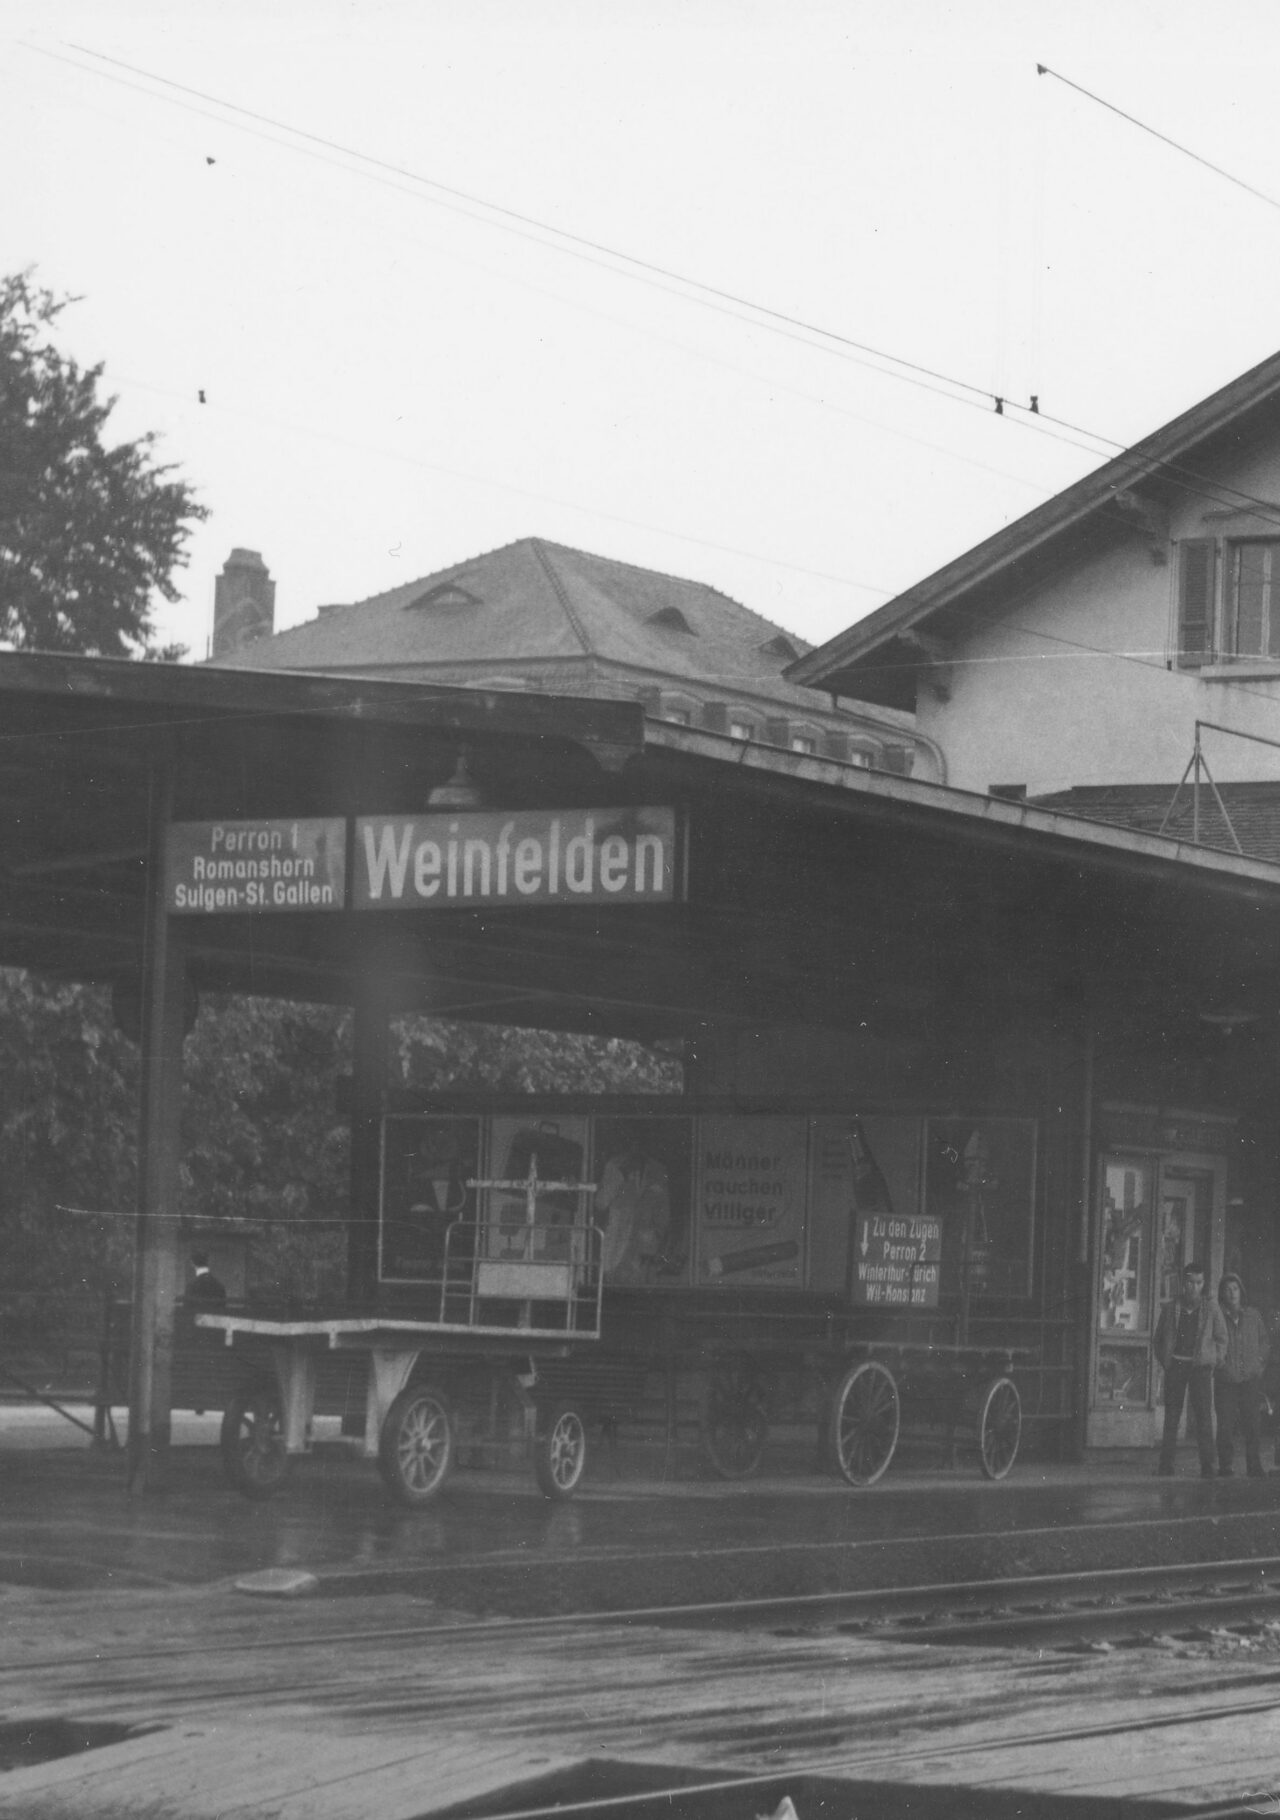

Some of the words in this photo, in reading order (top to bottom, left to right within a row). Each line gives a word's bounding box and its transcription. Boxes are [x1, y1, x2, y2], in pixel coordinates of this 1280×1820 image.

[212, 826, 282, 850] Perron
[290, 824, 298, 848] 1
[193, 857, 315, 880] Romanshorn
[363, 818, 664, 899] Weinfelden
[175, 884, 270, 911] Sulgen-St.
[273, 883, 333, 905] Gallen
[705, 1179, 783, 1195] rauchen
[704, 1202, 777, 1225] Villiger
[873, 1216, 886, 1237] Zu
[888, 1219, 906, 1238] den
[883, 1241, 916, 1260] Perron
[919, 1242, 926, 1261] 2
[858, 1262, 936, 1282] Winterthur-ürich
